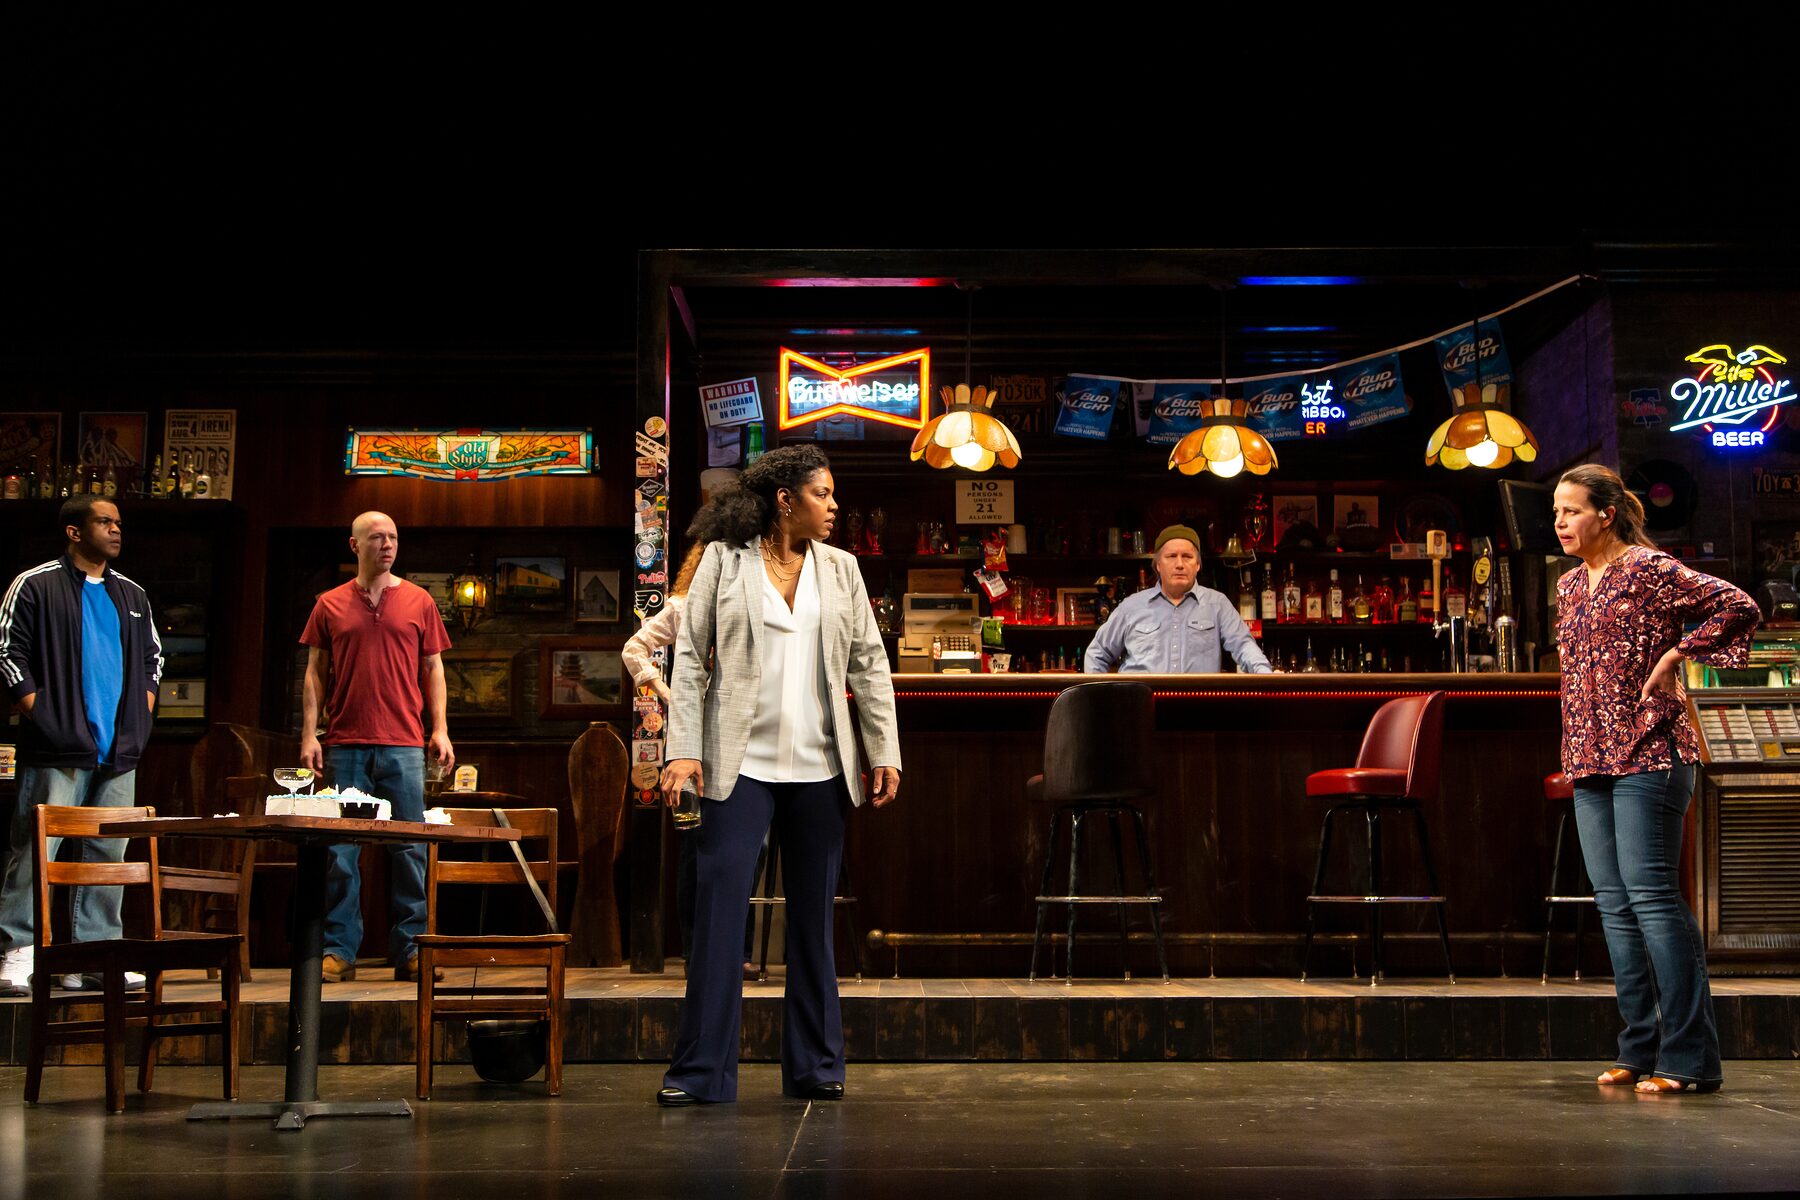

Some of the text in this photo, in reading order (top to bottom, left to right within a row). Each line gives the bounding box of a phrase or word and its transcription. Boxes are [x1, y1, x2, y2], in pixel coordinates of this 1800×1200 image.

[1459, 336, 1494, 357] BUD
[1453, 343, 1501, 369] LIGHT
[1358, 370, 1392, 387] BUD
[706, 382, 750, 399] WARNING
[788, 376, 920, 404] Budweiser
[1352, 378, 1397, 397] LIGHT
[709, 396, 754, 411] NO LIFEGUARD
[1080, 391, 1110, 404] BUD
[1171, 399, 1201, 407] BUD
[1260, 392, 1294, 403] BUD
[1671, 378, 1790, 421] Miller
[720, 407, 746, 419] ON DUTY
[1071, 400, 1112, 412] LIGHT
[1164, 408, 1201, 416] LIGHT
[1254, 400, 1299, 413] LIGHT
[200, 420, 230, 433] ARENA
[1305, 421, 1327, 435] ER
[1712, 431, 1765, 447] BEER
[464, 440, 486, 454] Old
[451, 450, 485, 468] Style
[971, 482, 999, 491] NO
[976, 503, 995, 513] 21
